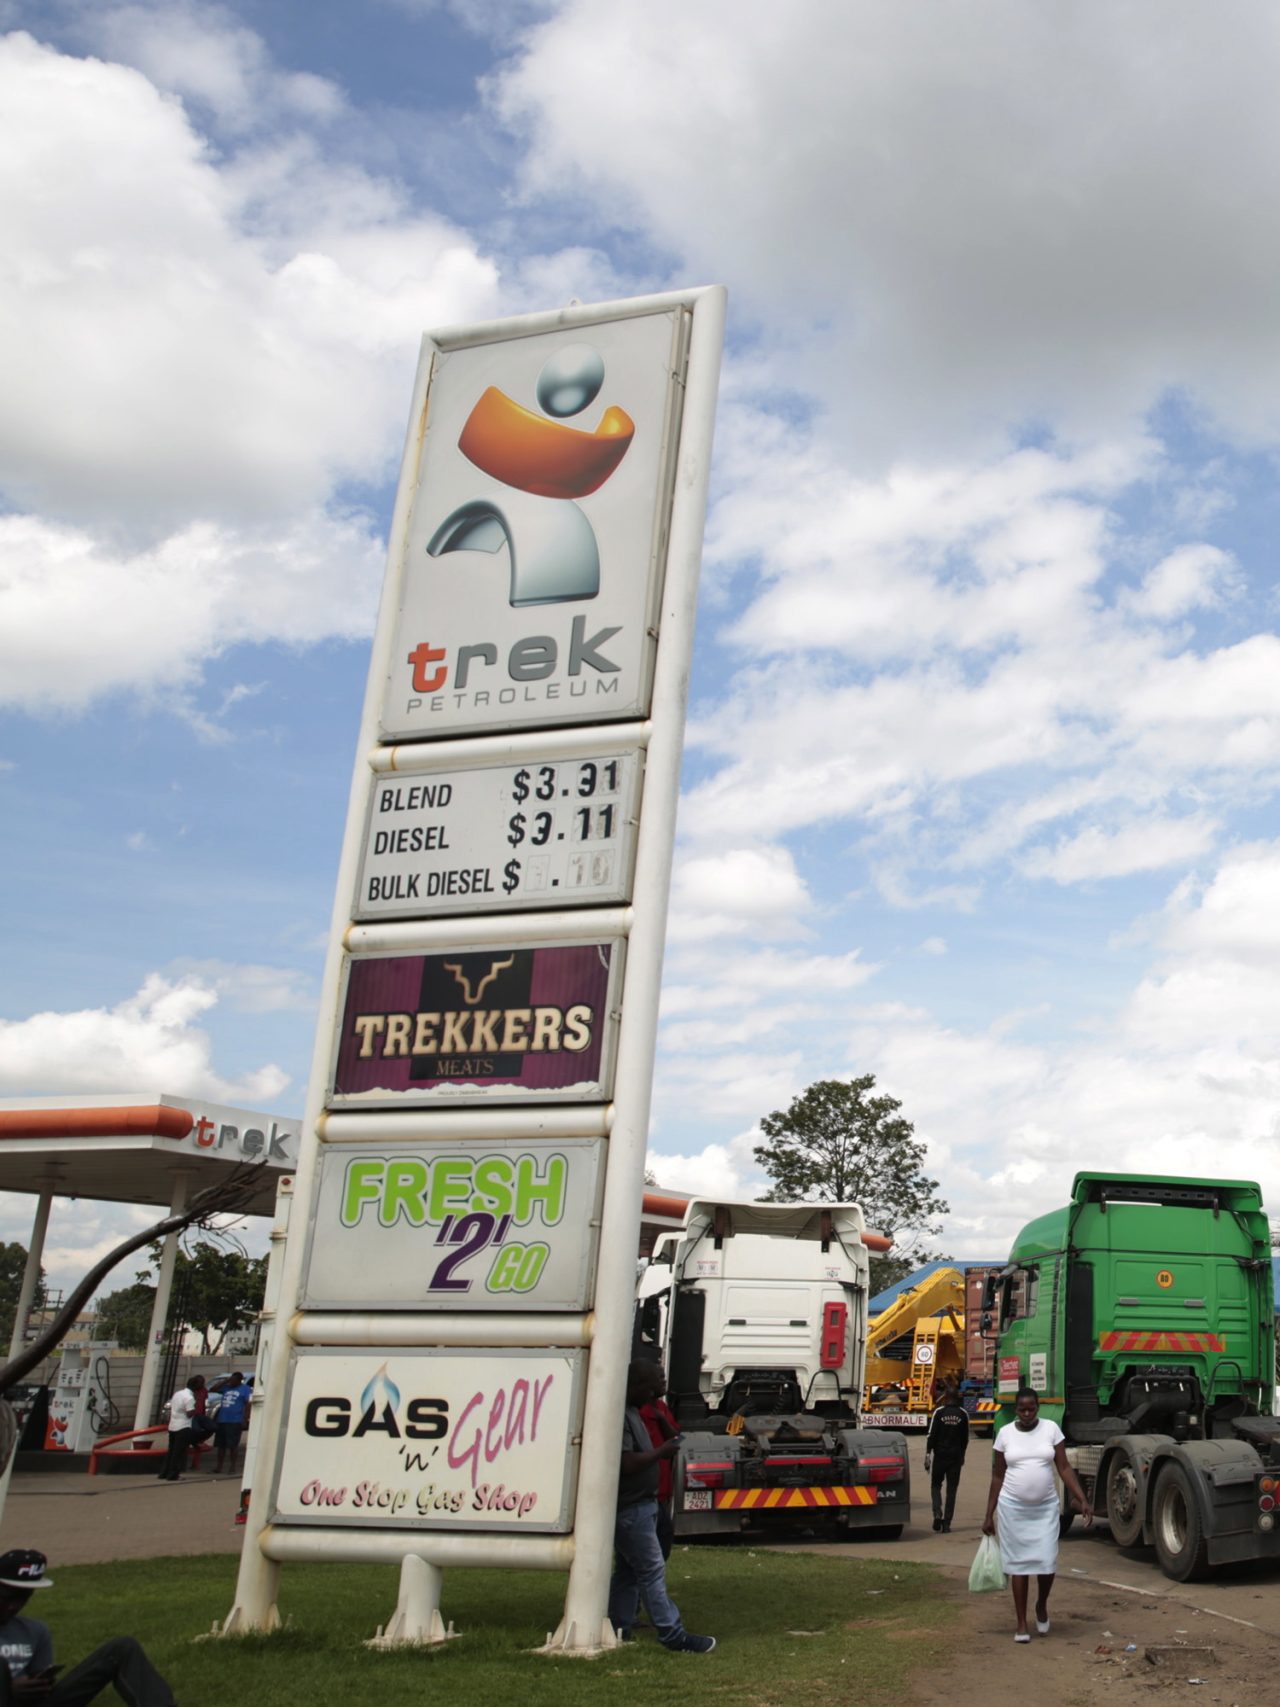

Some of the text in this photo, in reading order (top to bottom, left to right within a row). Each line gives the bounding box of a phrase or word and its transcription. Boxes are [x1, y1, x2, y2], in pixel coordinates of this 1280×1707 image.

[407, 615, 624, 693] trek
[406, 678, 619, 714] PETROLEUM
[380, 784, 452, 812] BLEND
[374, 826, 450, 855] DIESEL
[368, 874, 421, 901] BULK
[427, 868, 495, 896] DIESEL
[355, 1005, 593, 1059] TREKKERS
[436, 1059, 494, 1076] MEATS
[195, 1116, 291, 1160] trek
[341, 1154, 568, 1227] FRESH
[485, 1241, 550, 1294] GO
[305, 1397, 449, 1439] GAS
[448, 1374, 554, 1489] Gear
[300, 1479, 538, 1518] One Stop Gas Shop
[877, 1490, 896, 1498] AN
